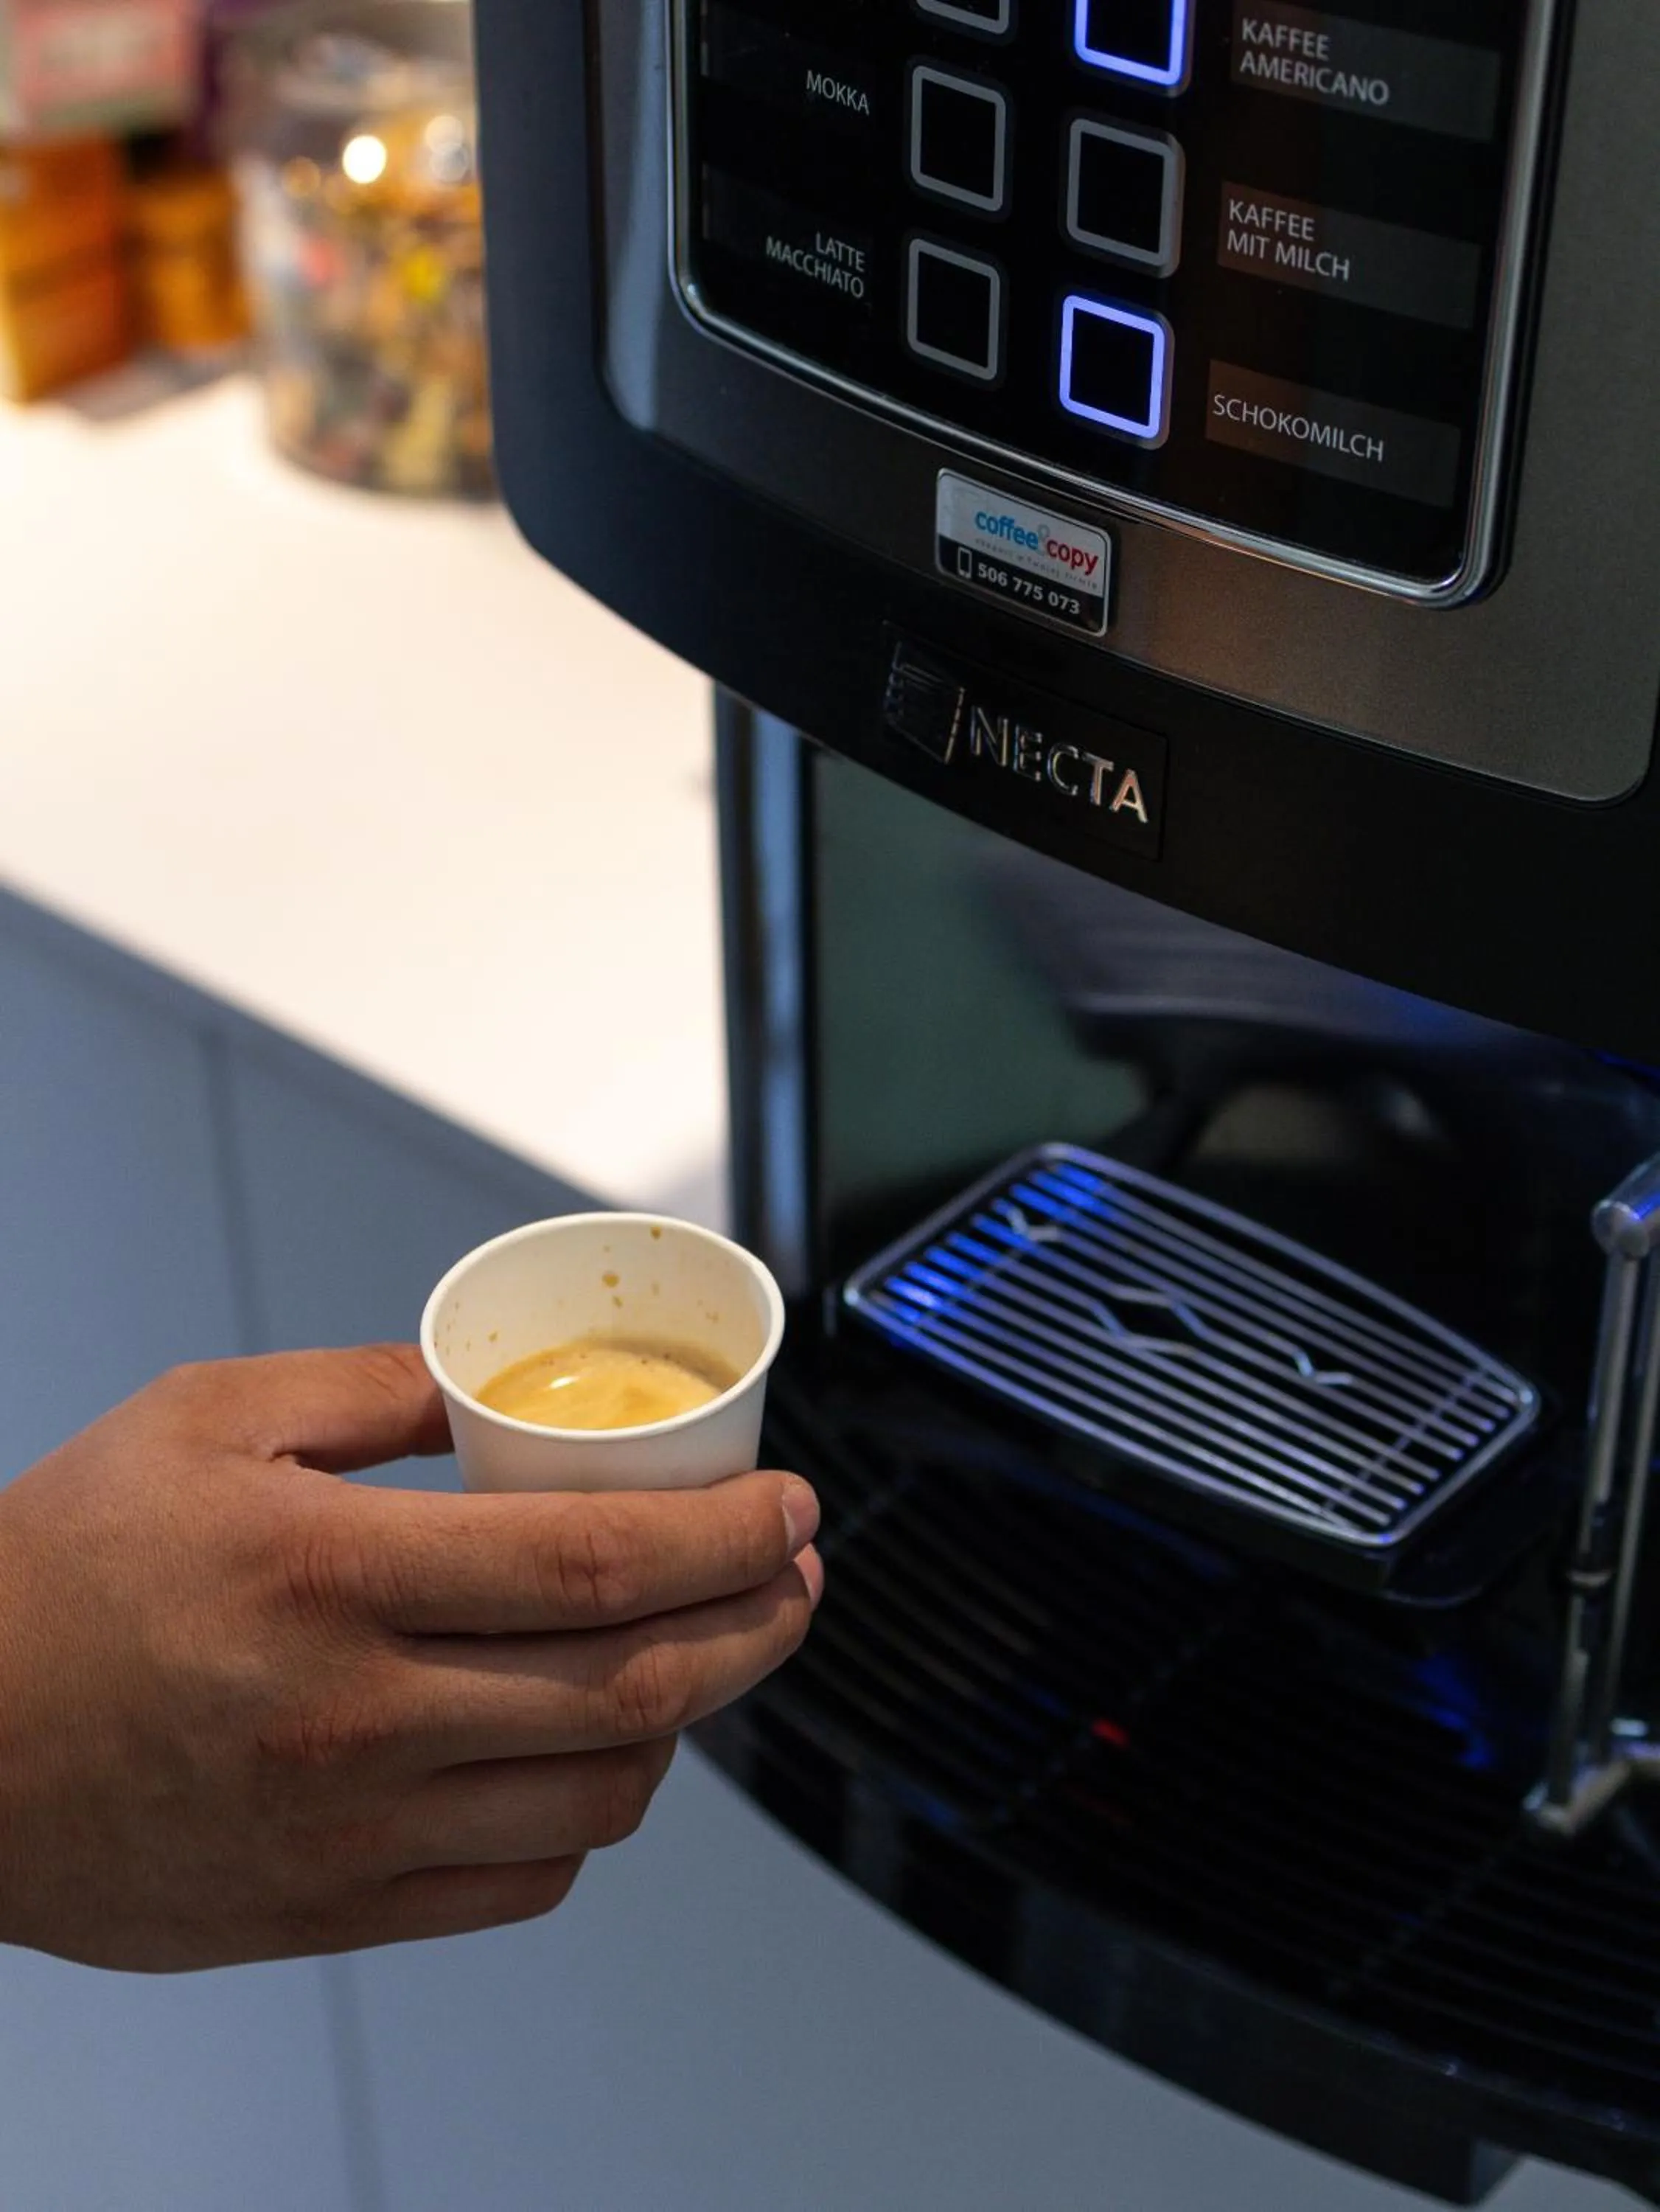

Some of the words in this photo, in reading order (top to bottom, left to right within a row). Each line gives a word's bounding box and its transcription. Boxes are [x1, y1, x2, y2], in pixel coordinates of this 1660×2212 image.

[1241, 18, 1331, 60] KAFFEE
[806, 70, 870, 115] MOKKA
[1240, 51, 1389, 105] AMERICANO
[1229, 199, 1315, 240] KAFFEE
[766, 236, 865, 298] MACCHIATO
[815, 232, 865, 271] LATTE
[1227, 229, 1267, 260] MIT
[1276, 242, 1350, 281] MILCH
[1213, 394, 1384, 462] SCHOKOMILCH
[977, 563, 1008, 588] 506
[1013, 576, 1045, 601] 775
[1047, 591, 1081, 615] 073
[971, 706, 1148, 824] NECTA
